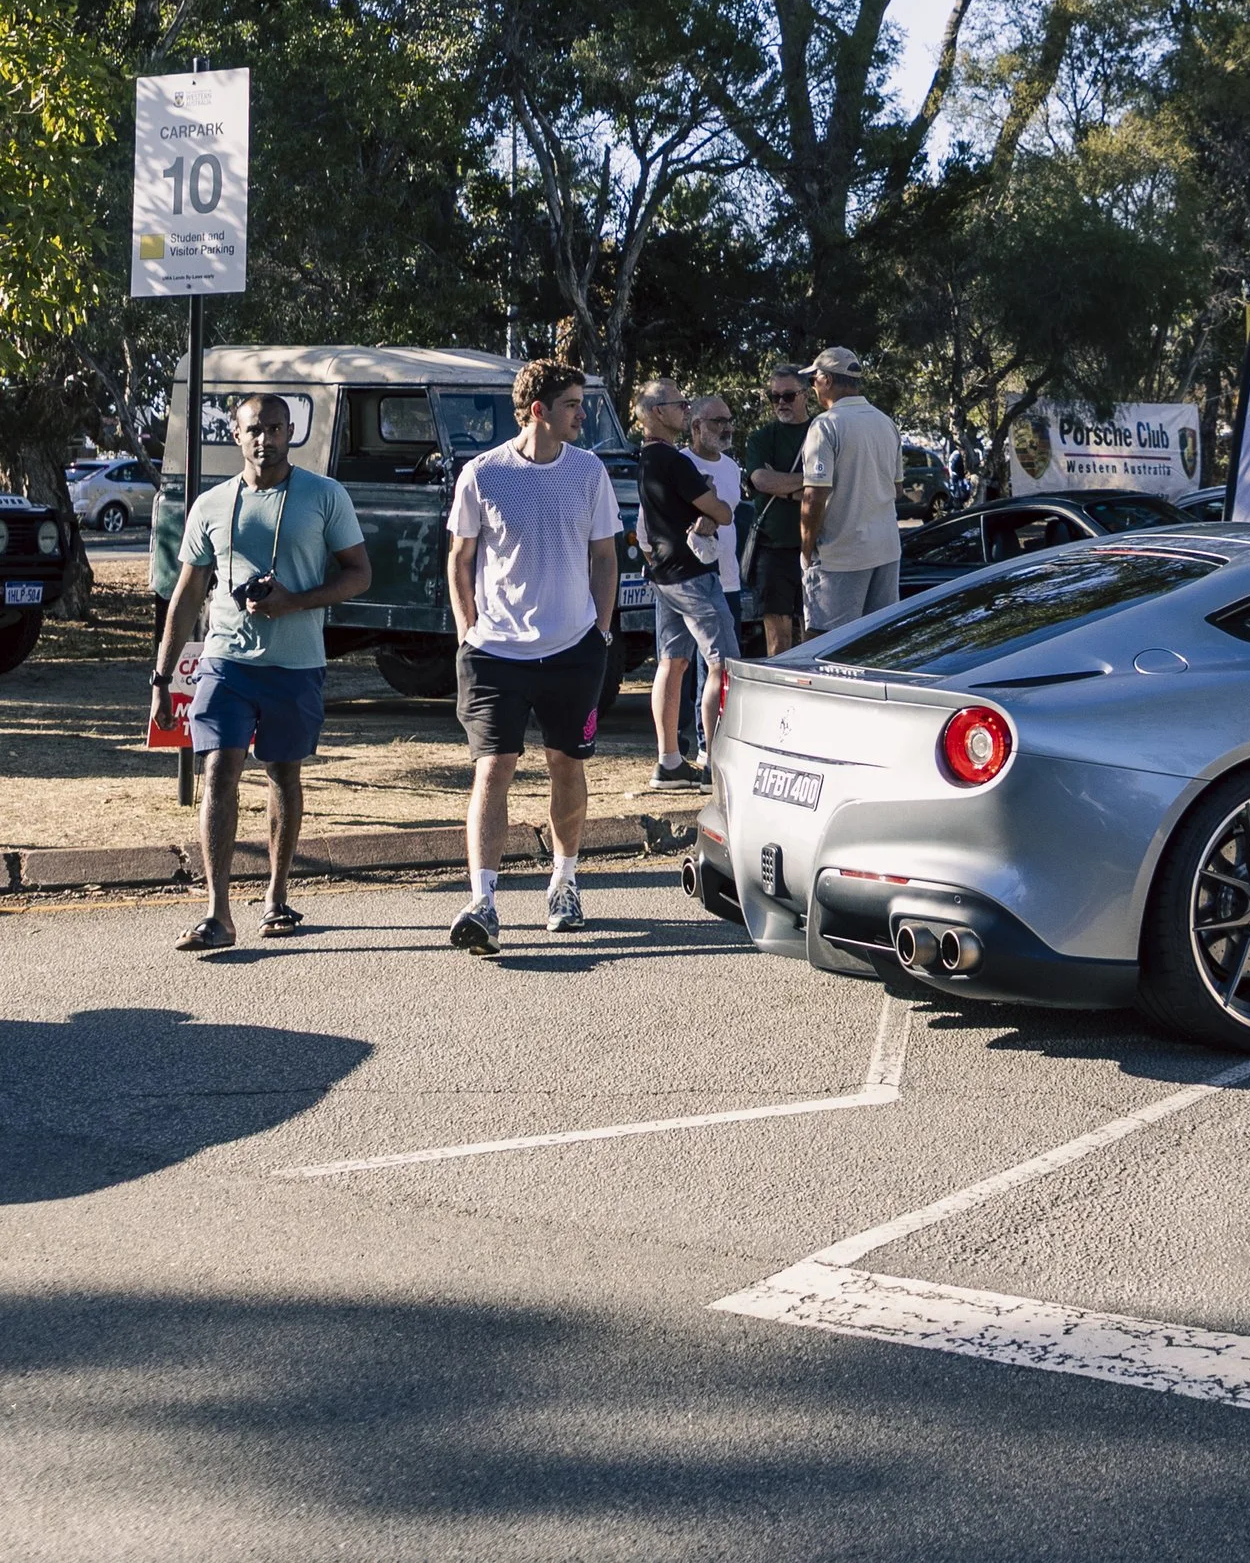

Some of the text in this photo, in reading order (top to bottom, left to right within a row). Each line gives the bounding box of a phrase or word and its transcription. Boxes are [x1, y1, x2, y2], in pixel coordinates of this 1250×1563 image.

[161, 123, 223, 139] CARPARK
[163, 154, 222, 215] 10
[170, 231, 225, 244] Student and
[170, 244, 235, 257] Visitor Parking
[1060, 418, 1170, 449] Porsche Club
[1067, 461, 1171, 476] Western Australia
[760, 768, 818, 804] 1FBT400
